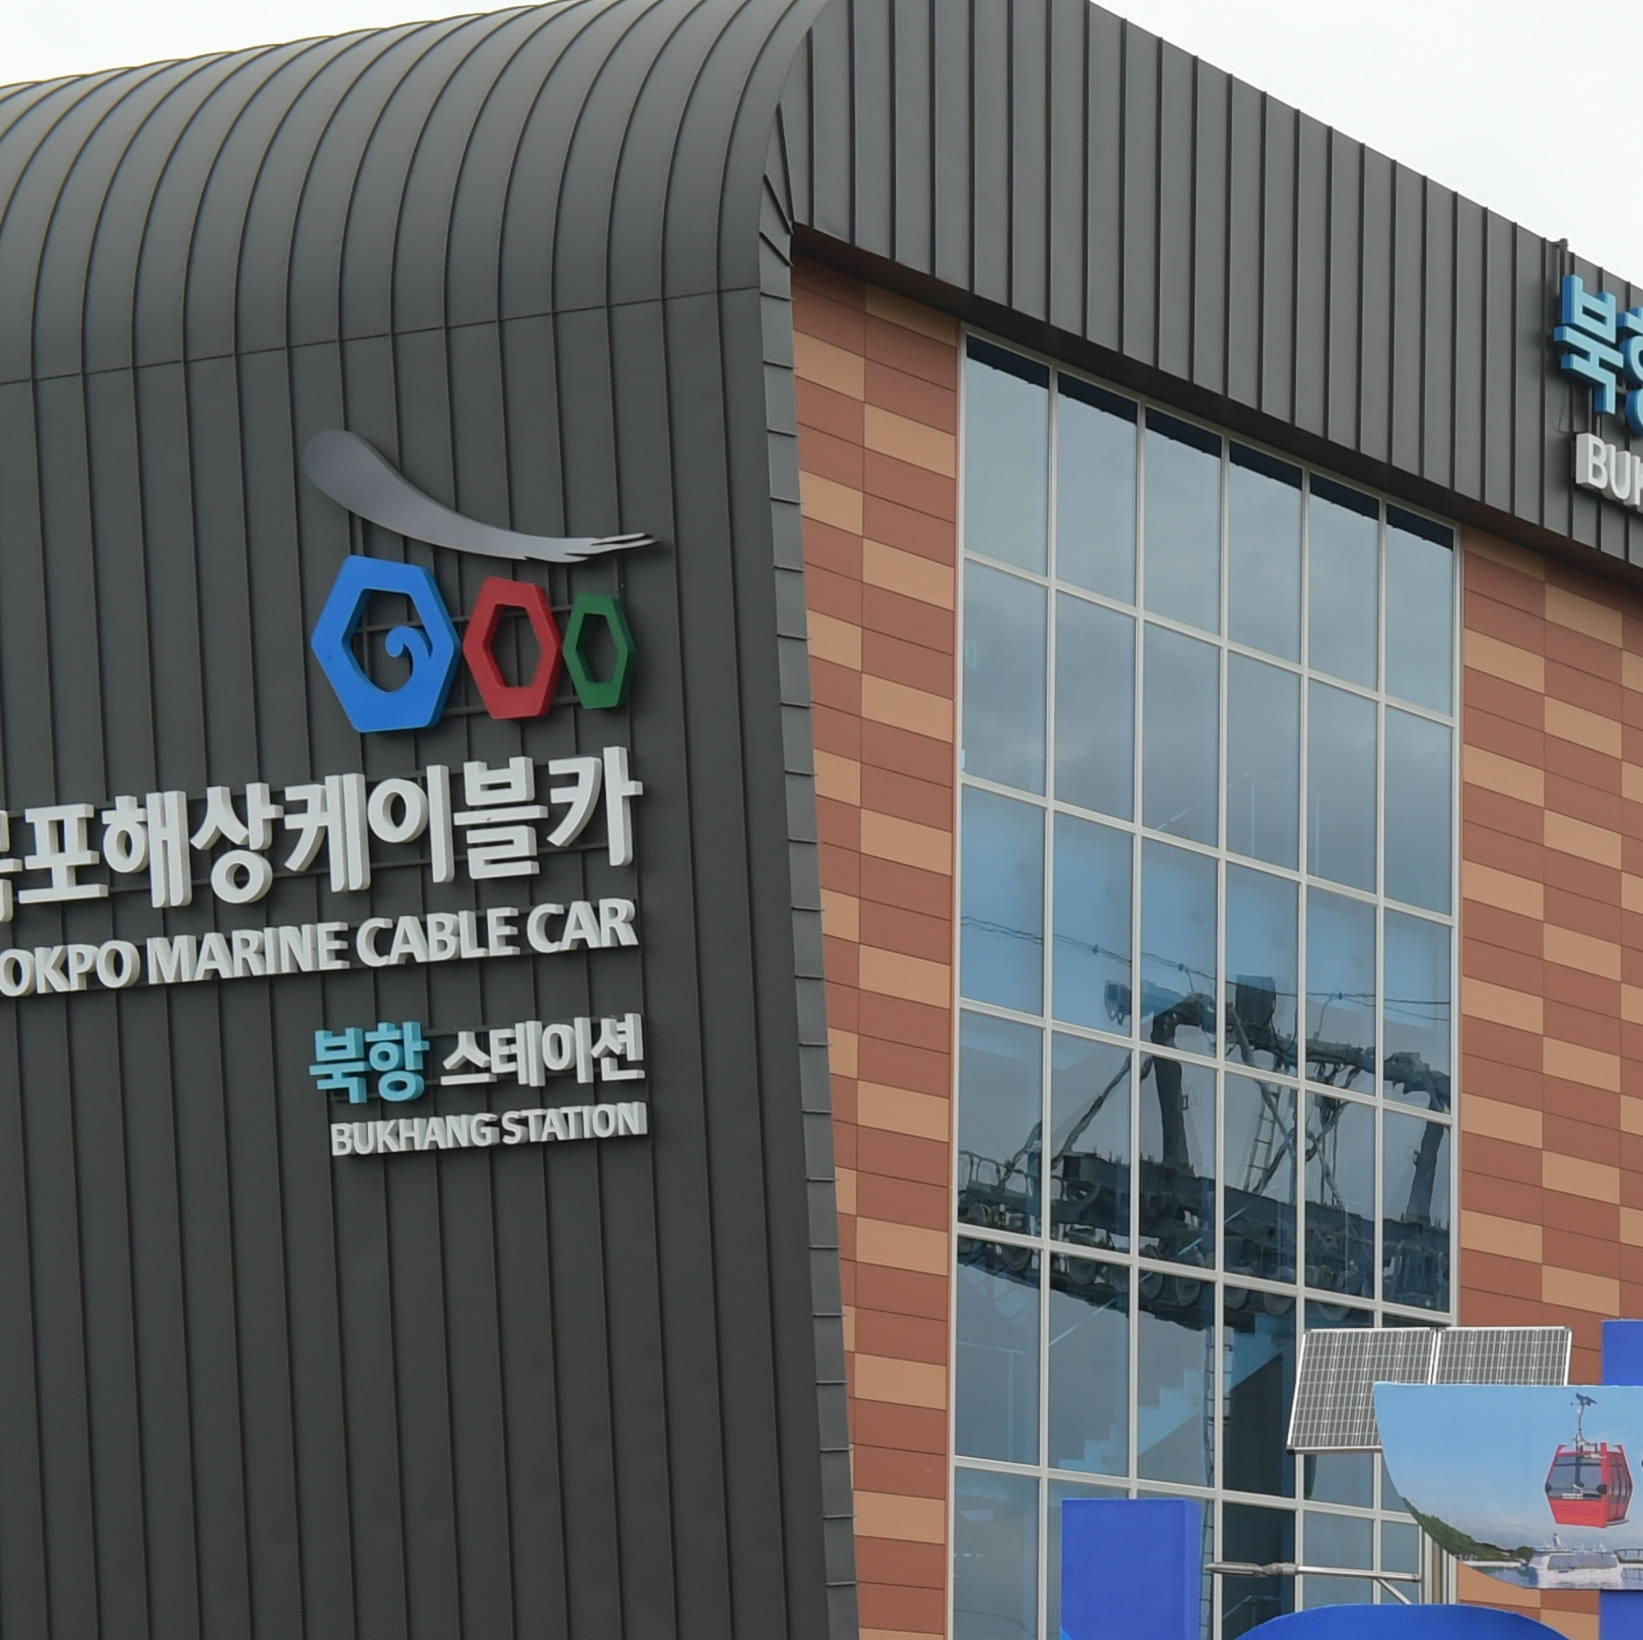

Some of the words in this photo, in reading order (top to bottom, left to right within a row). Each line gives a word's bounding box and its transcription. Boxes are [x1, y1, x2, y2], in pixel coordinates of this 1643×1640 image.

[147, 920, 350, 984] MARINE
[356, 906, 521, 970] CABLE
[526, 897, 640, 956] CAR
[309, 1020, 430, 1104] 북항
[440, 1012, 646, 1087] 스테이션
[330, 1112, 501, 1157] BUKHANG
[501, 1100, 648, 1146] STATION
